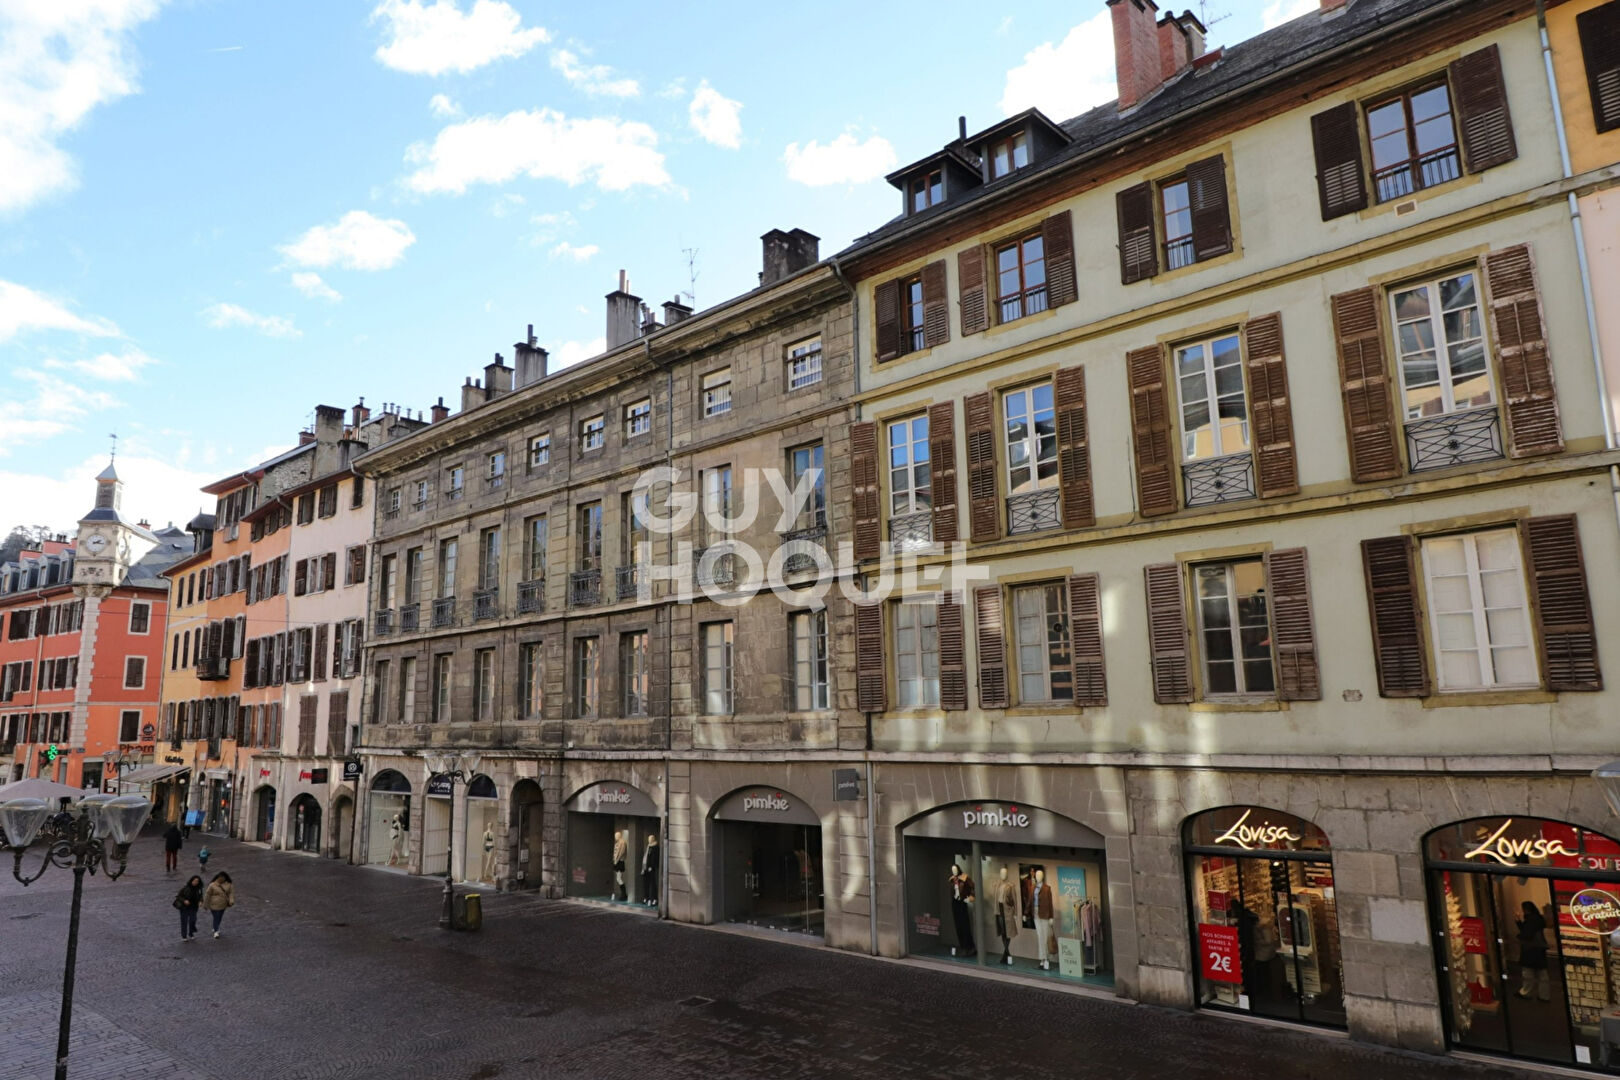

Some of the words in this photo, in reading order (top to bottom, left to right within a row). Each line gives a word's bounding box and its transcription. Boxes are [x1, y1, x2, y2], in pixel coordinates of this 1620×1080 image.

[597, 788, 631, 804] pimkie
[744, 792, 789, 812] pimkie
[963, 805, 1030, 829] pimkie
[1214, 808, 1301, 850] Lovisa
[1464, 818, 1579, 867] Lovisa
[1573, 902, 1612, 913] Piercing
[1582, 908, 1620, 920] Gratuit
[1214, 933, 1235, 941] BONNES
[1209, 952, 1232, 973] 2€
